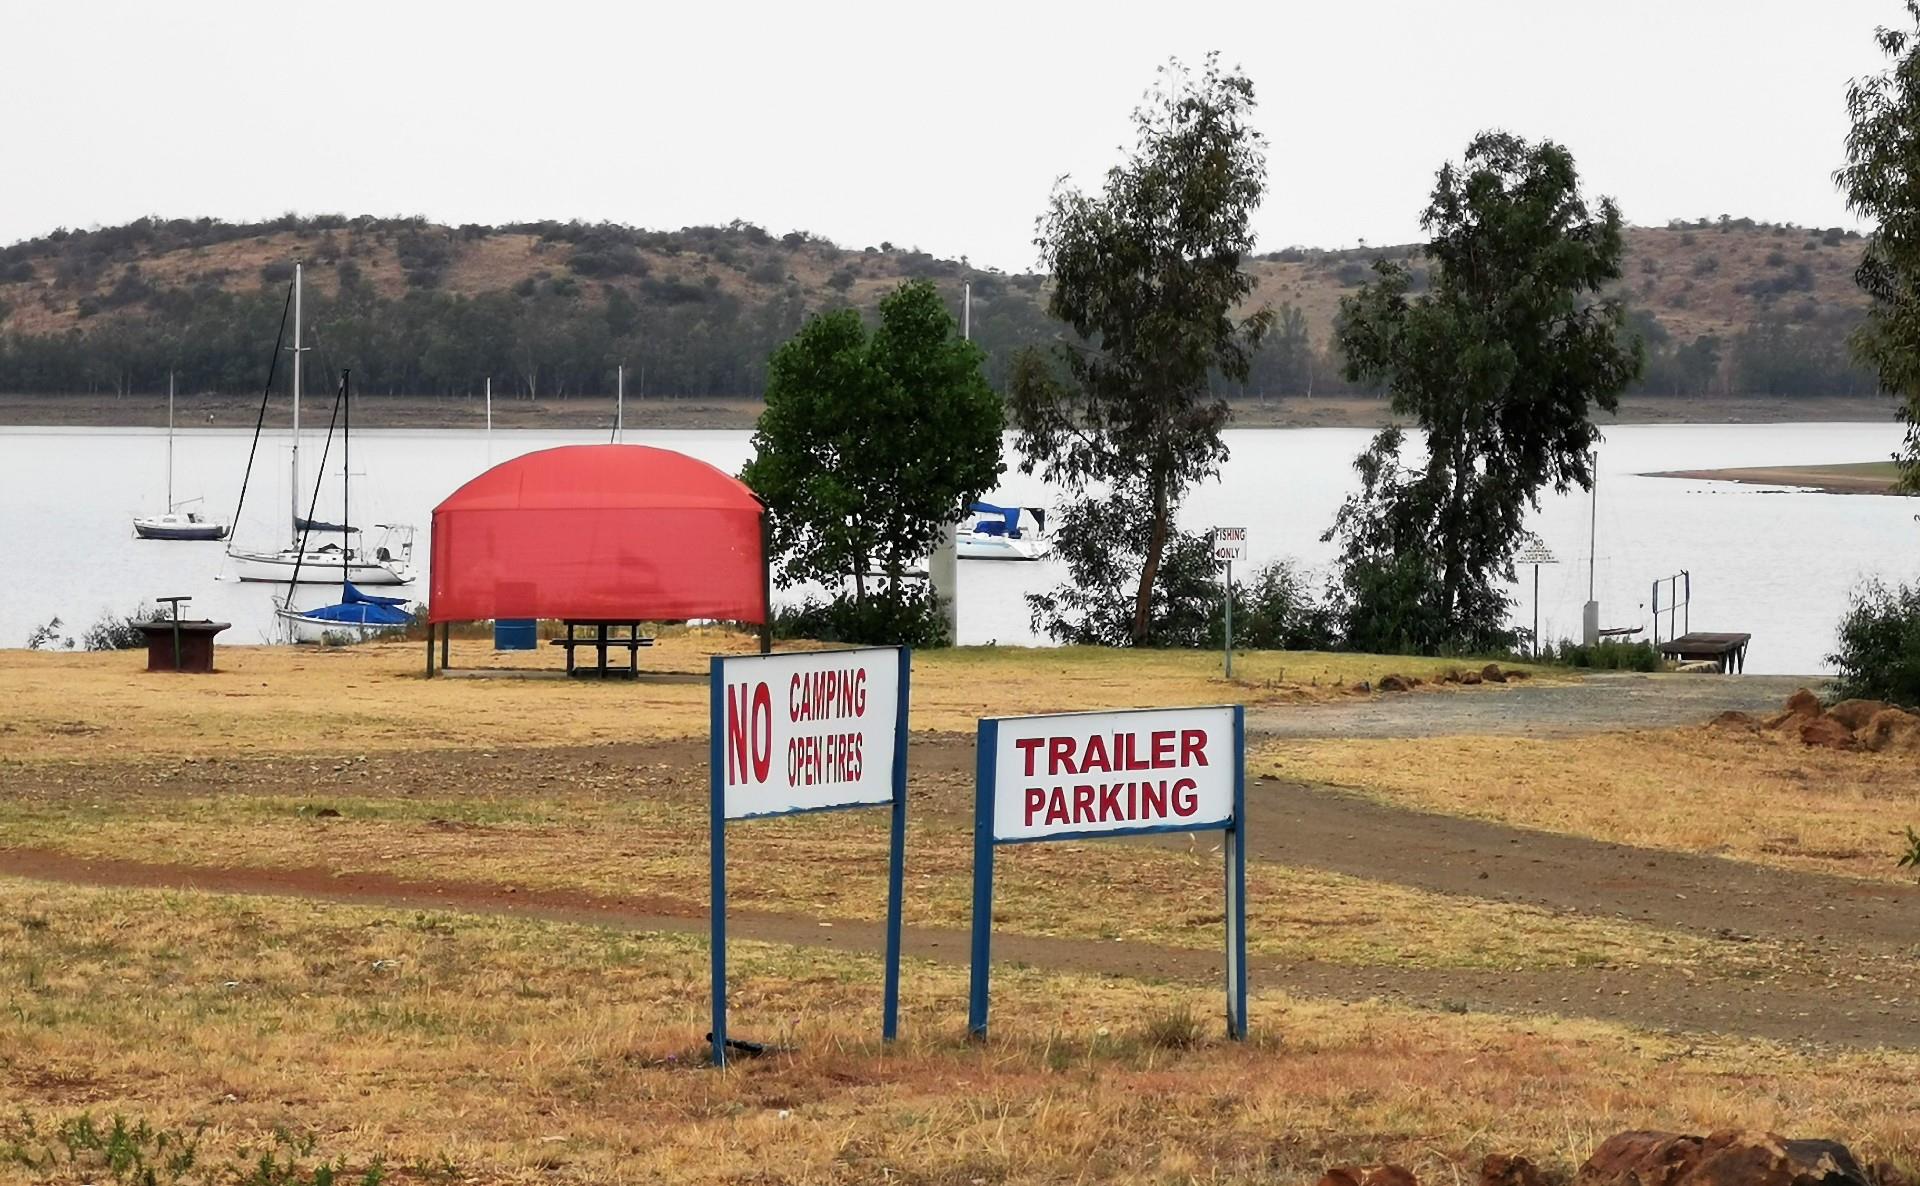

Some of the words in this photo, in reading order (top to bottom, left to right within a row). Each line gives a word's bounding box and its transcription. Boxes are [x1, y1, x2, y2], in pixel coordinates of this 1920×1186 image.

[1215, 529, 1246, 541] FISHING
[1220, 547, 1240, 559] ONLY
[789, 667, 866, 723] CAMPING
[728, 681, 772, 786] NO
[1015, 729, 1209, 777] TRAILER
[787, 736, 823, 788] OPEN
[826, 731, 863, 784] FIRES
[1024, 778, 1198, 827] PARKING
